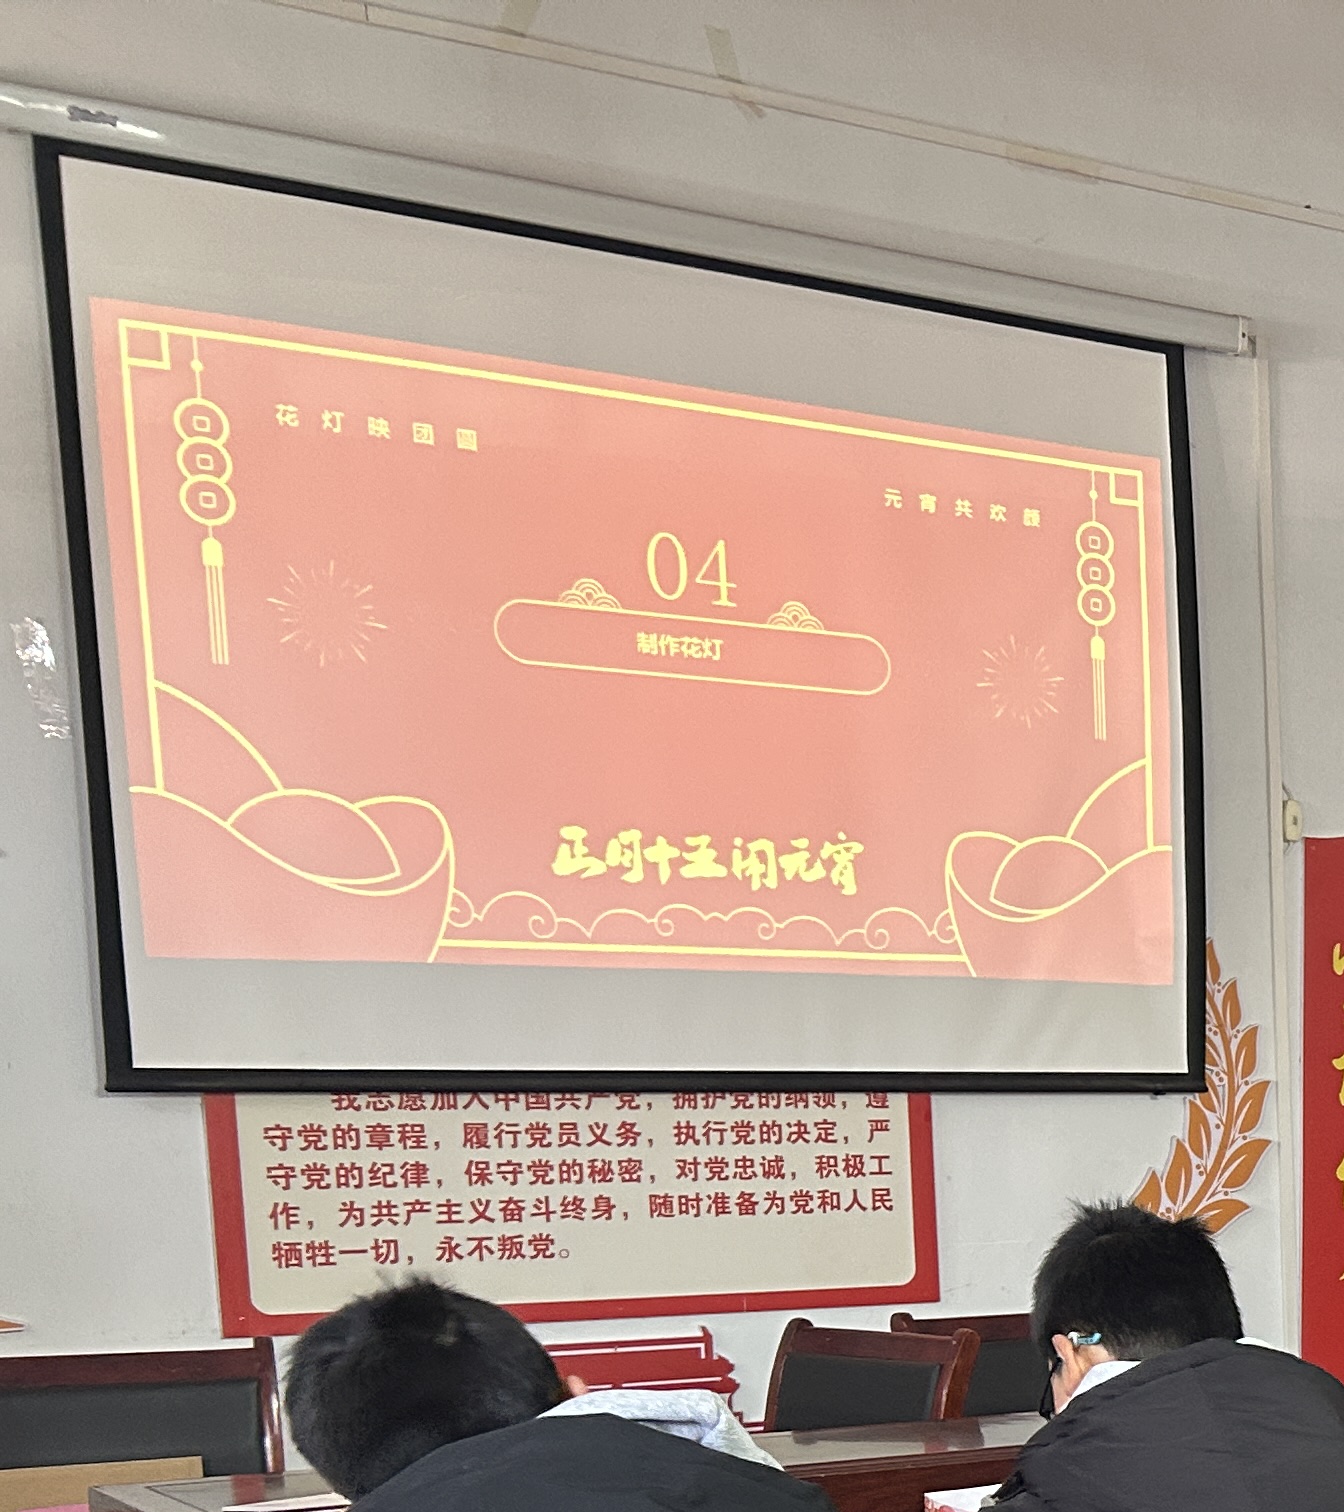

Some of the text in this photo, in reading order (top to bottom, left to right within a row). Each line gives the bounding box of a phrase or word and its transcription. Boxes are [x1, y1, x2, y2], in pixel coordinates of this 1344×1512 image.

[274, 403, 479, 452] 花灯映团圆
[883, 488, 1041, 528] 元宵共欢颜
[646, 531, 737, 608] 04
[636, 631, 724, 661] 制作花灯
[551, 825, 865, 896] 正月十五闹元宵
[263, 1118, 891, 1152] 守党的章程，履行党员义务，执行党的决定，严
[266, 1153, 893, 1191] 守党的纪律，保守党的秘密，对党忠诚，积极工
[269, 1188, 894, 1231] 作，为共产主义奋斗终身，随时准备为党和人民
[271, 1232, 571, 1269] 牺牲一切，永不叛党。
